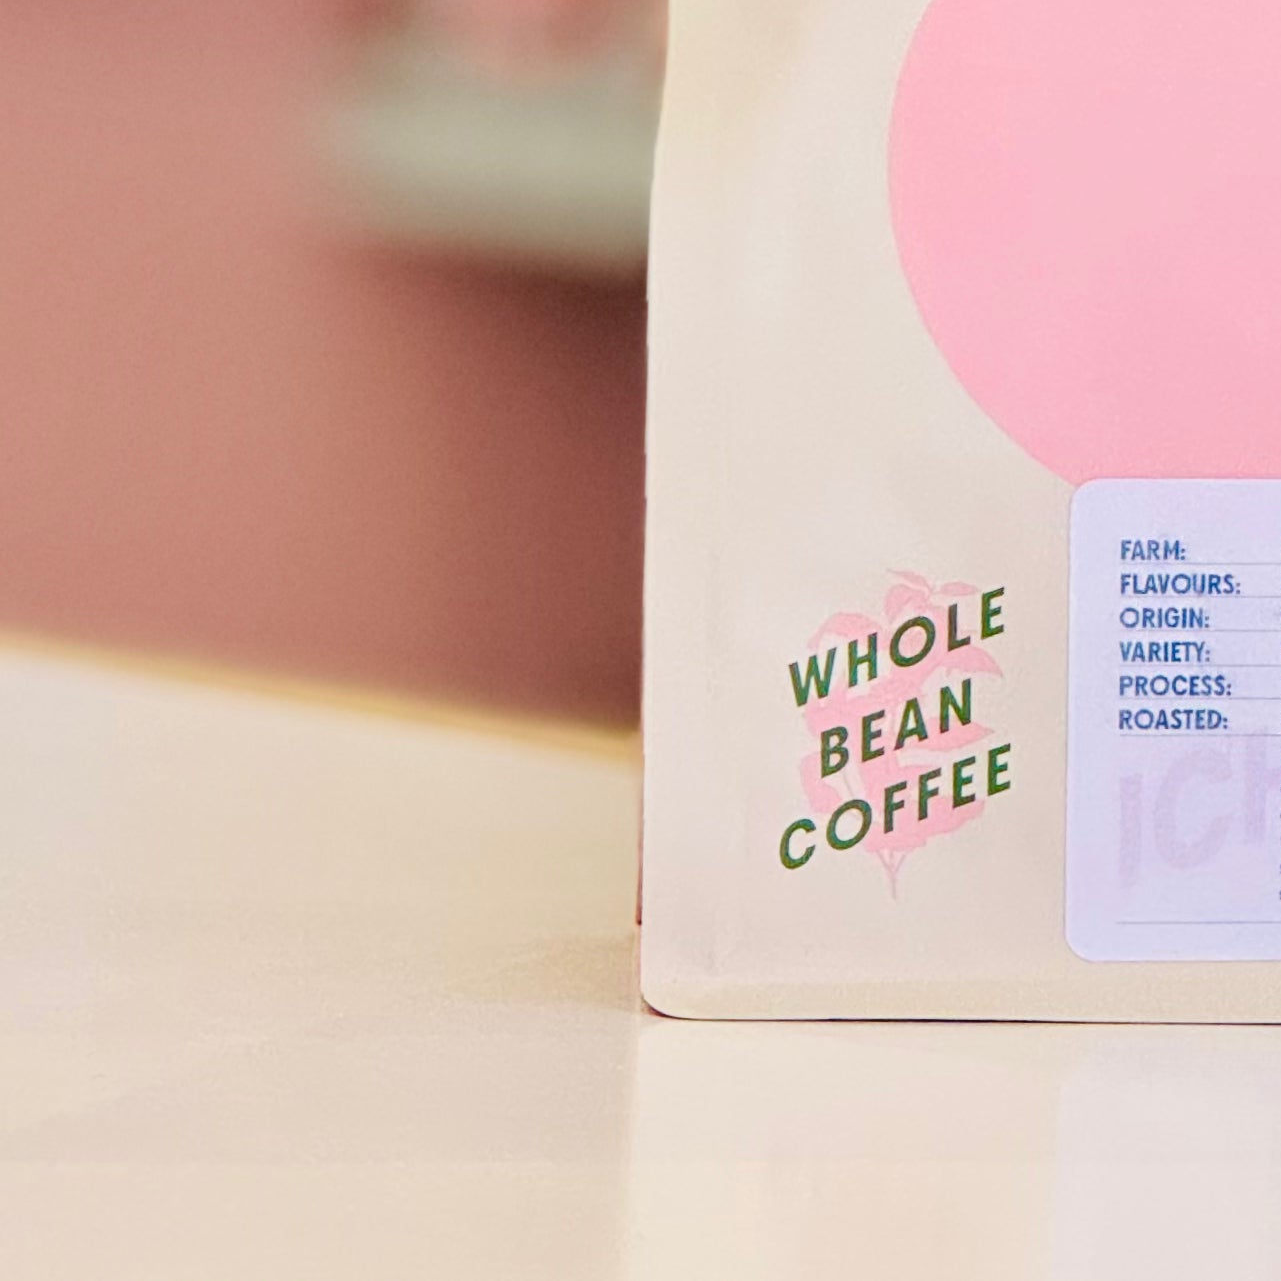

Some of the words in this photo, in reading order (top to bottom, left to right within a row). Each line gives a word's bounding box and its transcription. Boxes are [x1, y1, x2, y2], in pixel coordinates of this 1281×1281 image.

[1120, 539, 1187, 561] FARM:
[1120, 573, 1241, 595] FLAVOURS:
[1119, 607, 1210, 629] ORIGIN:
[788, 586, 1006, 708] WHOLE
[1119, 641, 1211, 663] VARIETY:
[1118, 674, 1232, 697] PROCESS:
[820, 677, 973, 779] BEAN
[1118, 708, 1229, 731] ROASTED:
[779, 742, 1012, 871] COFFEE
